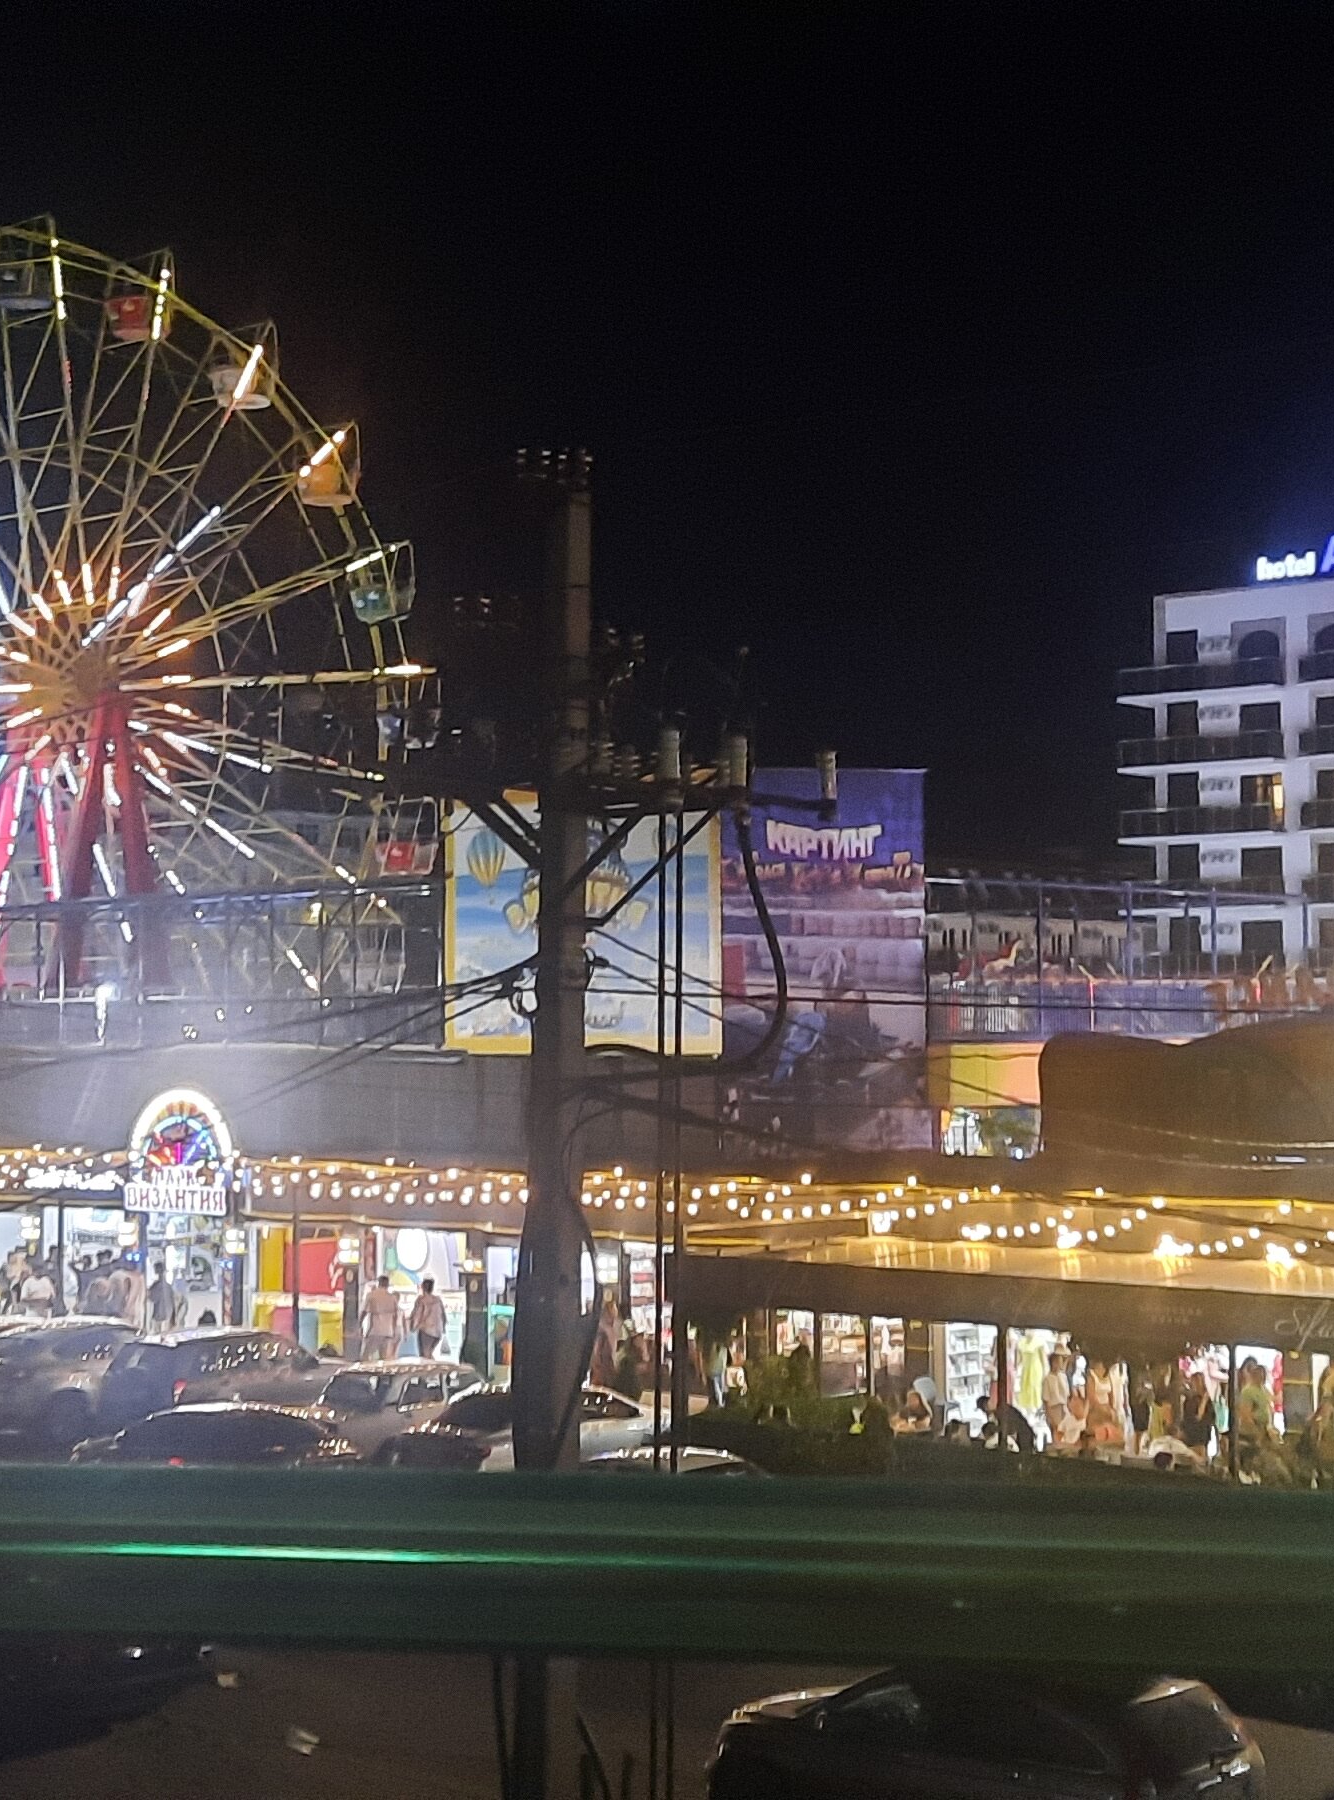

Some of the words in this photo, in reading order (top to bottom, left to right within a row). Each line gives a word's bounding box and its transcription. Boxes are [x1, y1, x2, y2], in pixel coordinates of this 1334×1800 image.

[1256, 551, 1317, 582] hotel
[766, 818, 882, 861] КАРТИНГ
[153, 1167, 198, 1187] ПАРК
[127, 1186, 224, 1212] ВИЗАНТИЯ
